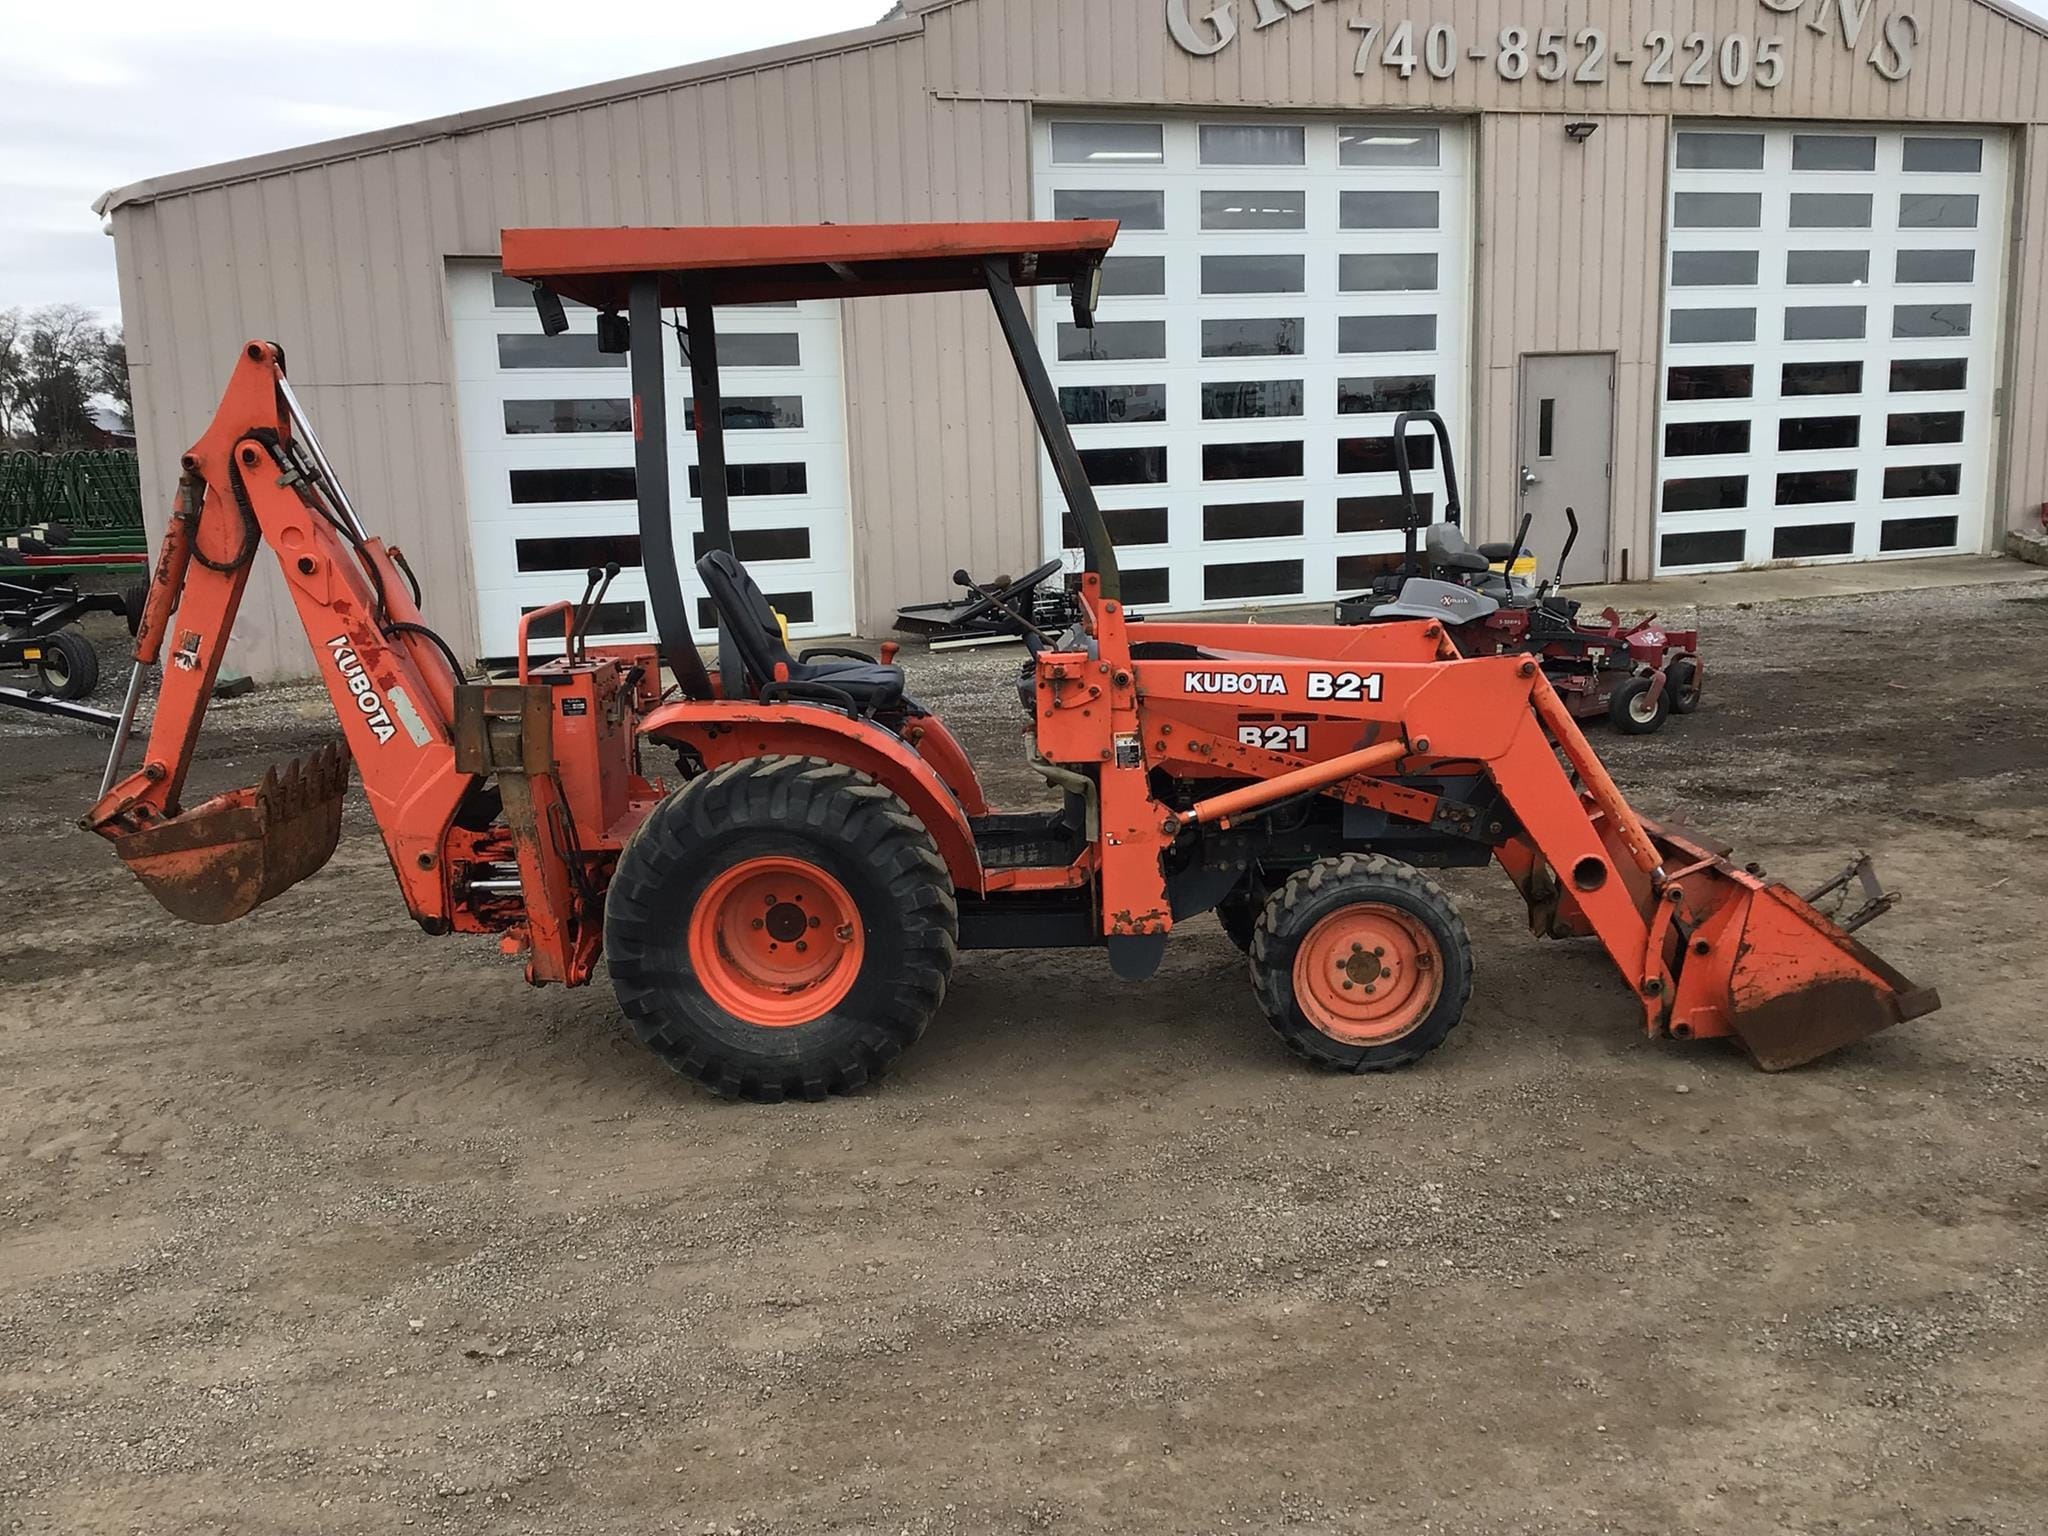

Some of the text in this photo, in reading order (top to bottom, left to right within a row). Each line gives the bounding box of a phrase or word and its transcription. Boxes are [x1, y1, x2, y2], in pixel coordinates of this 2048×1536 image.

[1348, 19, 1786, 88] 740-852-2205
[326, 633, 397, 745] KUBOTA
[1184, 671, 1383, 701] KUBOTA B21
[1237, 725, 1308, 752] B21
